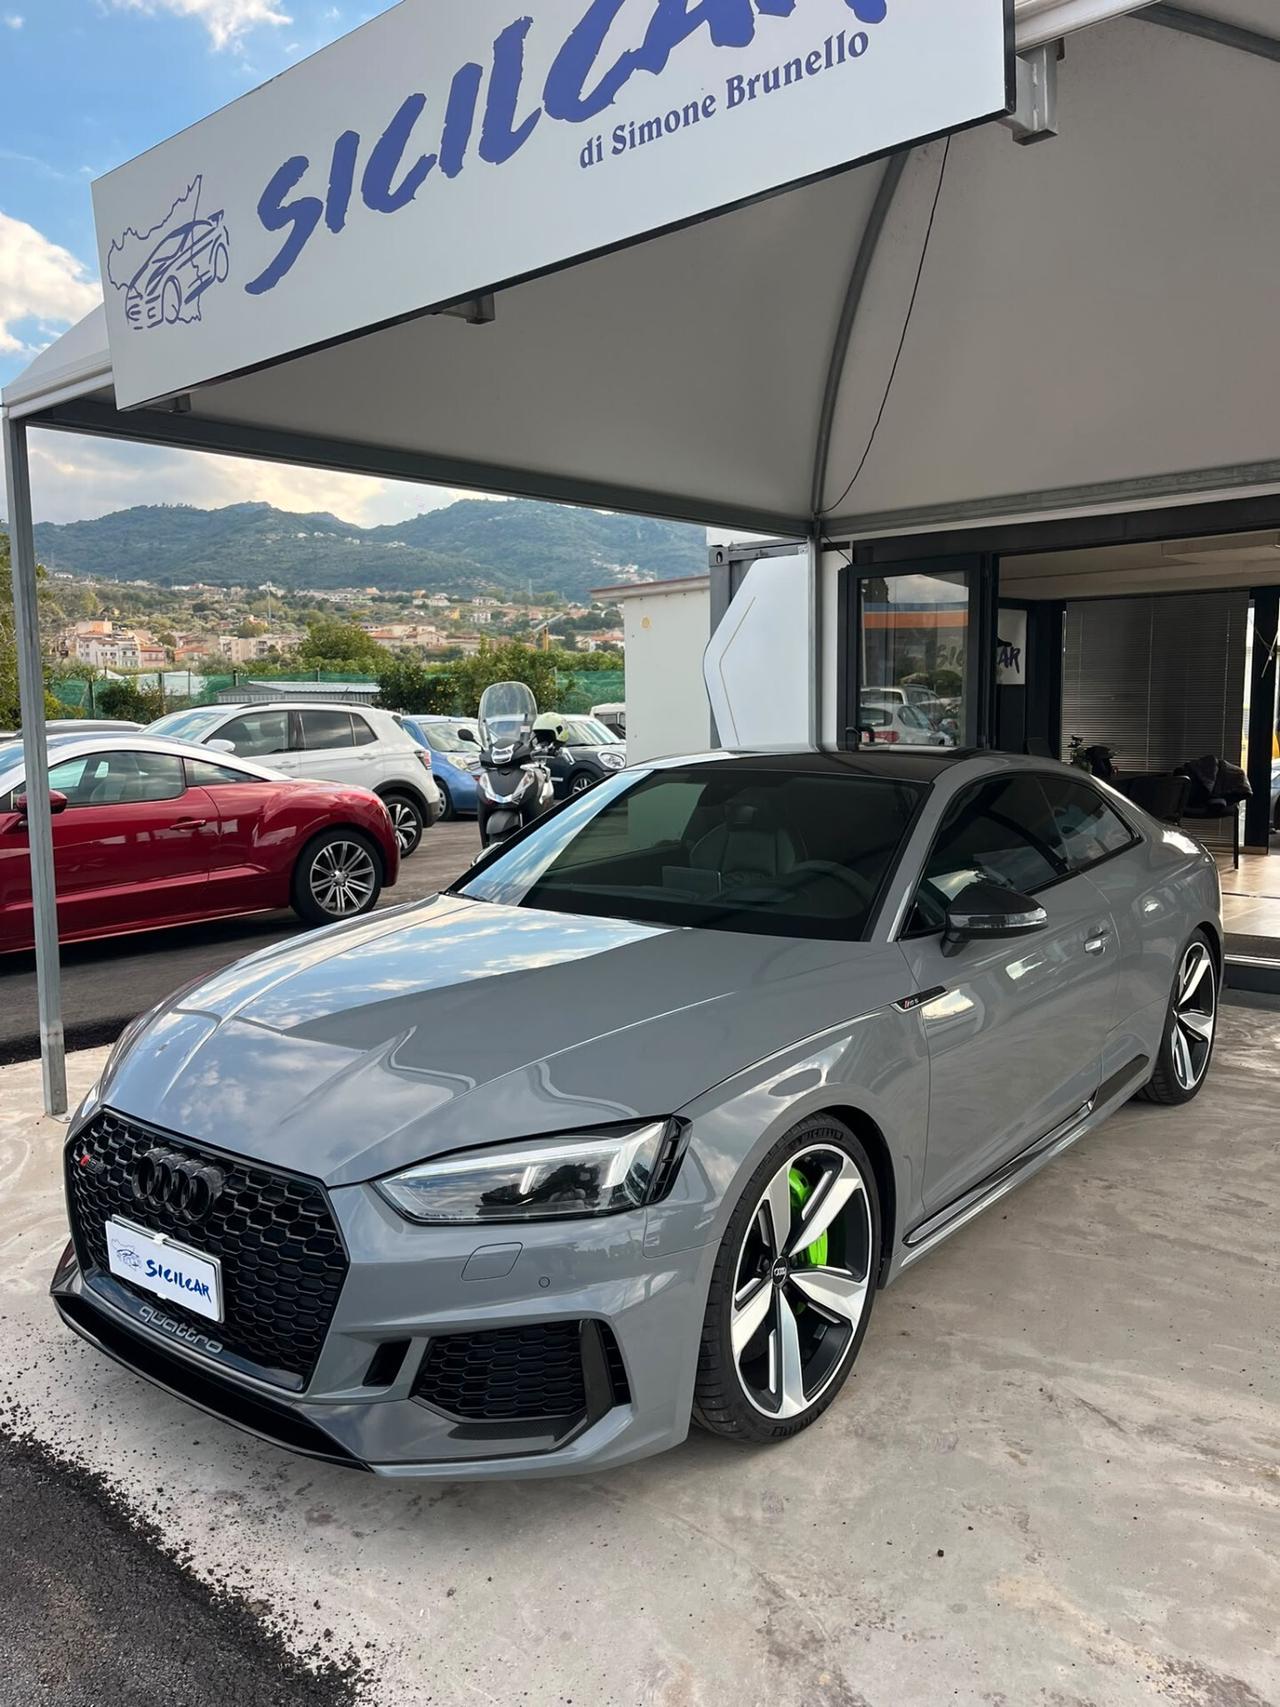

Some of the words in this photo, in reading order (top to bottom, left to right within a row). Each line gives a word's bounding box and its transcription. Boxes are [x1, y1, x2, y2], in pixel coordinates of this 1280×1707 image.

[580, 135, 603, 168] di
[611, 95, 717, 156] Simone
[726, 30, 869, 110] Brunello
[246, 0, 888, 296] SICILC
[145, 1259, 212, 1303] SICILCAR
[140, 1306, 223, 1354] quattro
